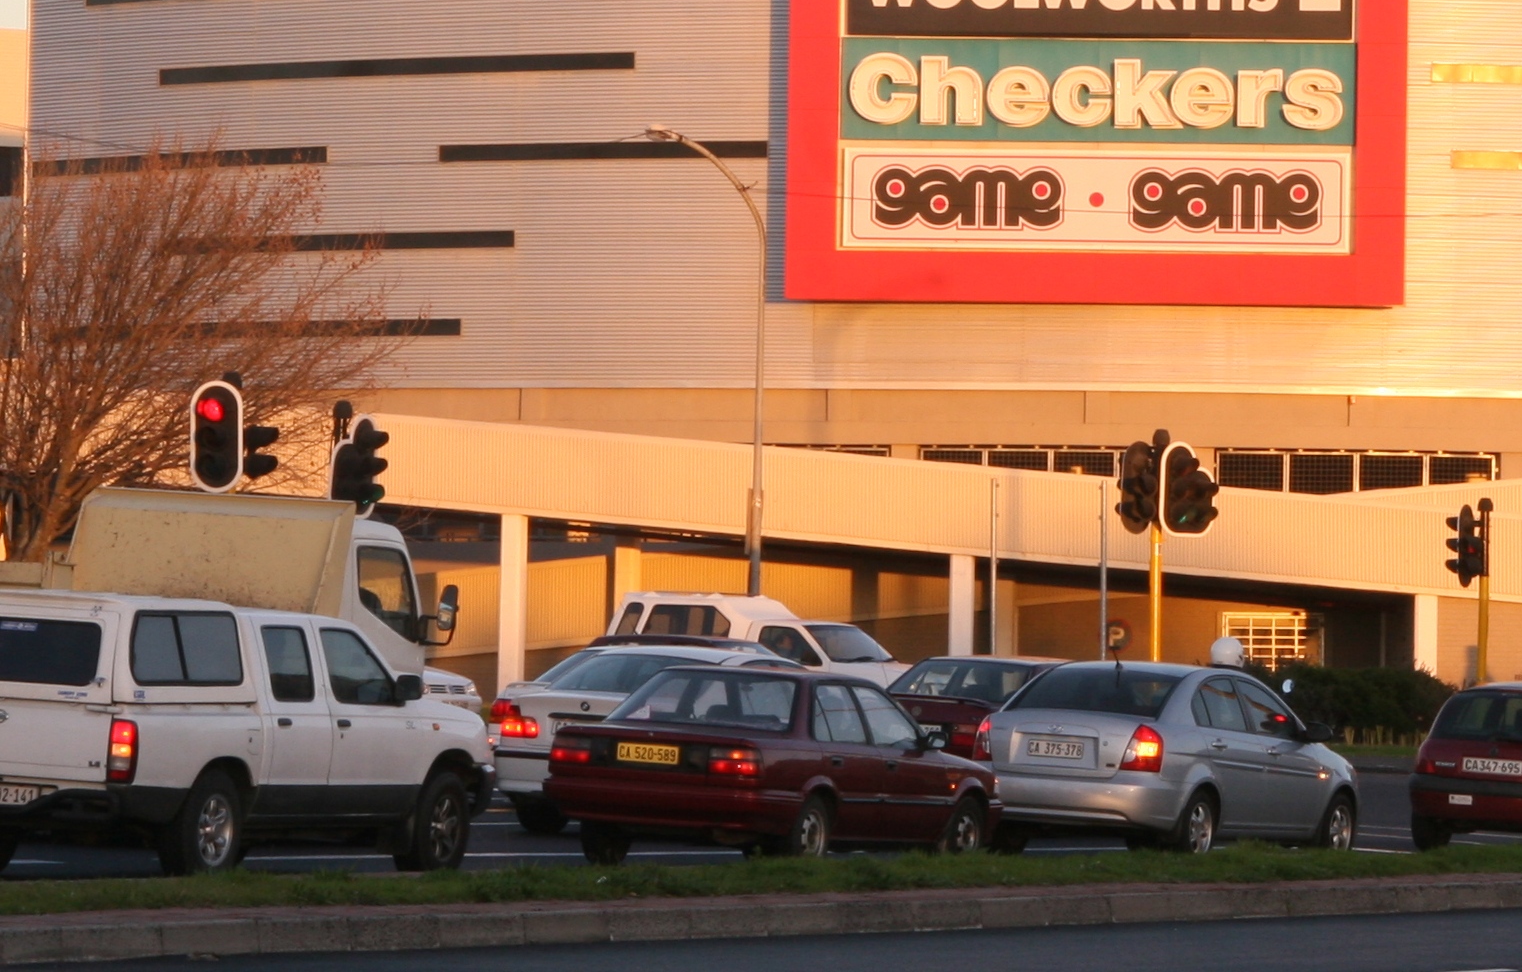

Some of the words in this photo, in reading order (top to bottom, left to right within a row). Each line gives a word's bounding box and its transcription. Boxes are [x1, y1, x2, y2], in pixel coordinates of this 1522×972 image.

[849, 52, 1344, 130] Checkers
[1109, 626, 1125, 647] P
[619, 745, 631, 759] CA
[634, 747, 677, 762] 520-589
[1029, 741, 1040, 754] CA
